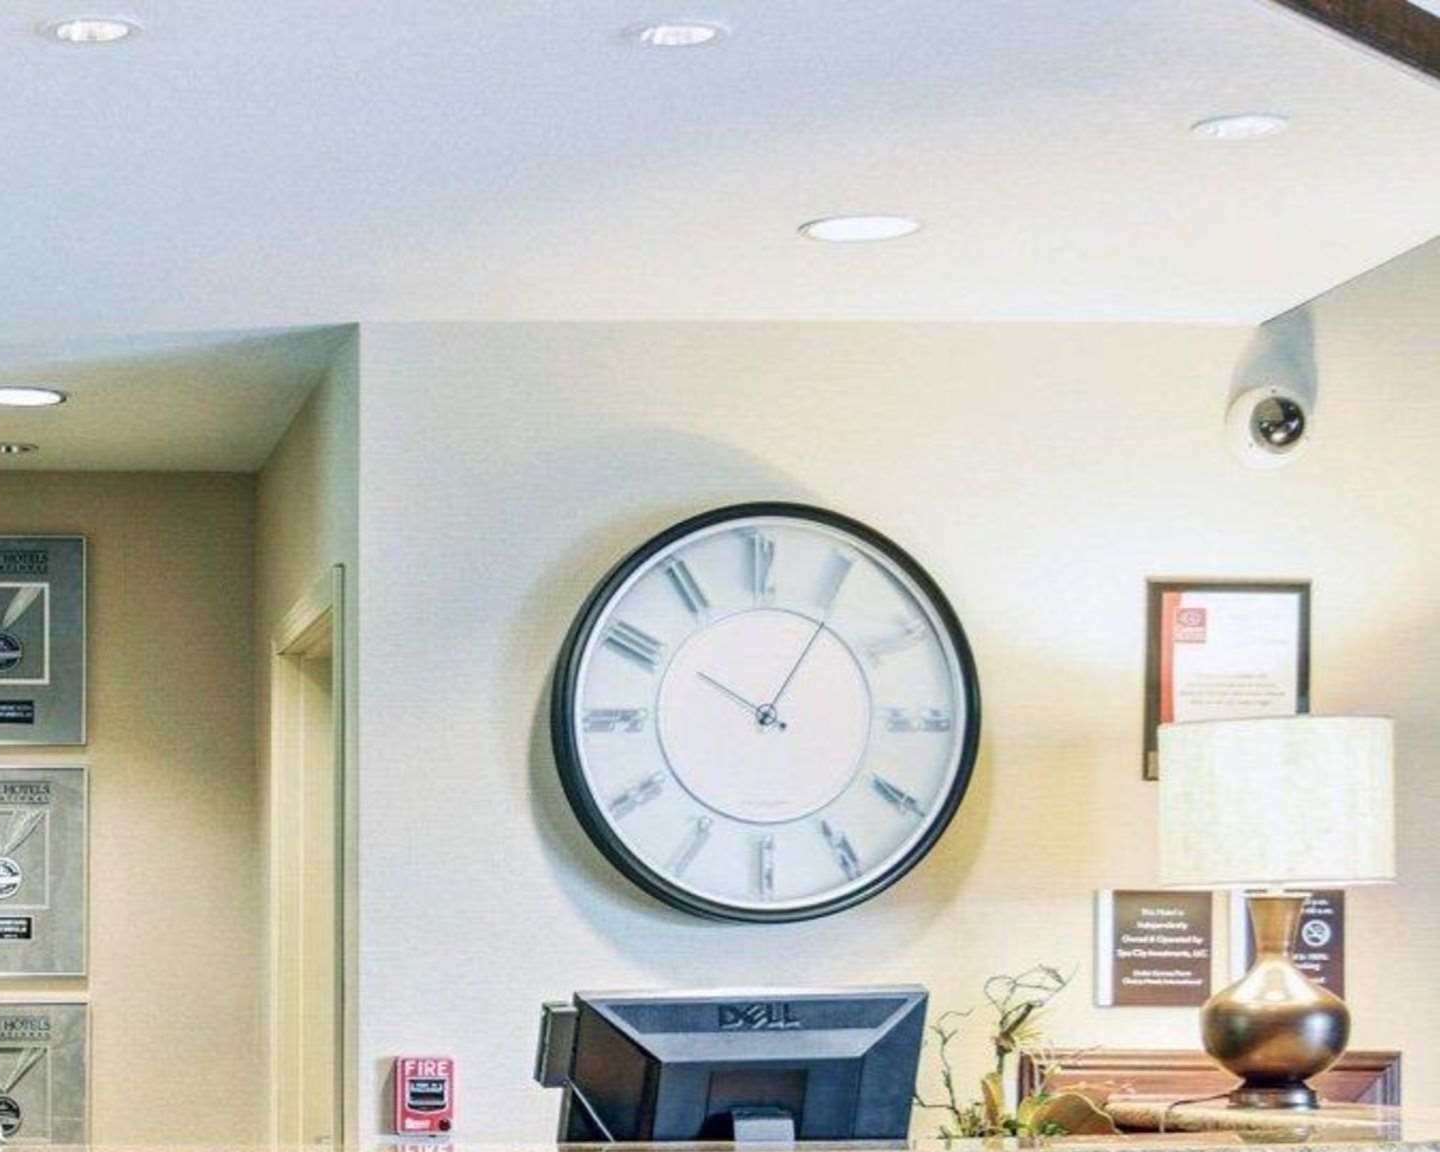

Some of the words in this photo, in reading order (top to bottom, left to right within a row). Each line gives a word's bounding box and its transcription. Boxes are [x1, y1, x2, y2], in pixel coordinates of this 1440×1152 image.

[3, 785, 50, 794] HOTELS
[719, 1003, 801, 1030] DELL
[4, 1020, 50, 1031] HOTELS
[405, 1060, 450, 1077] FIRE
